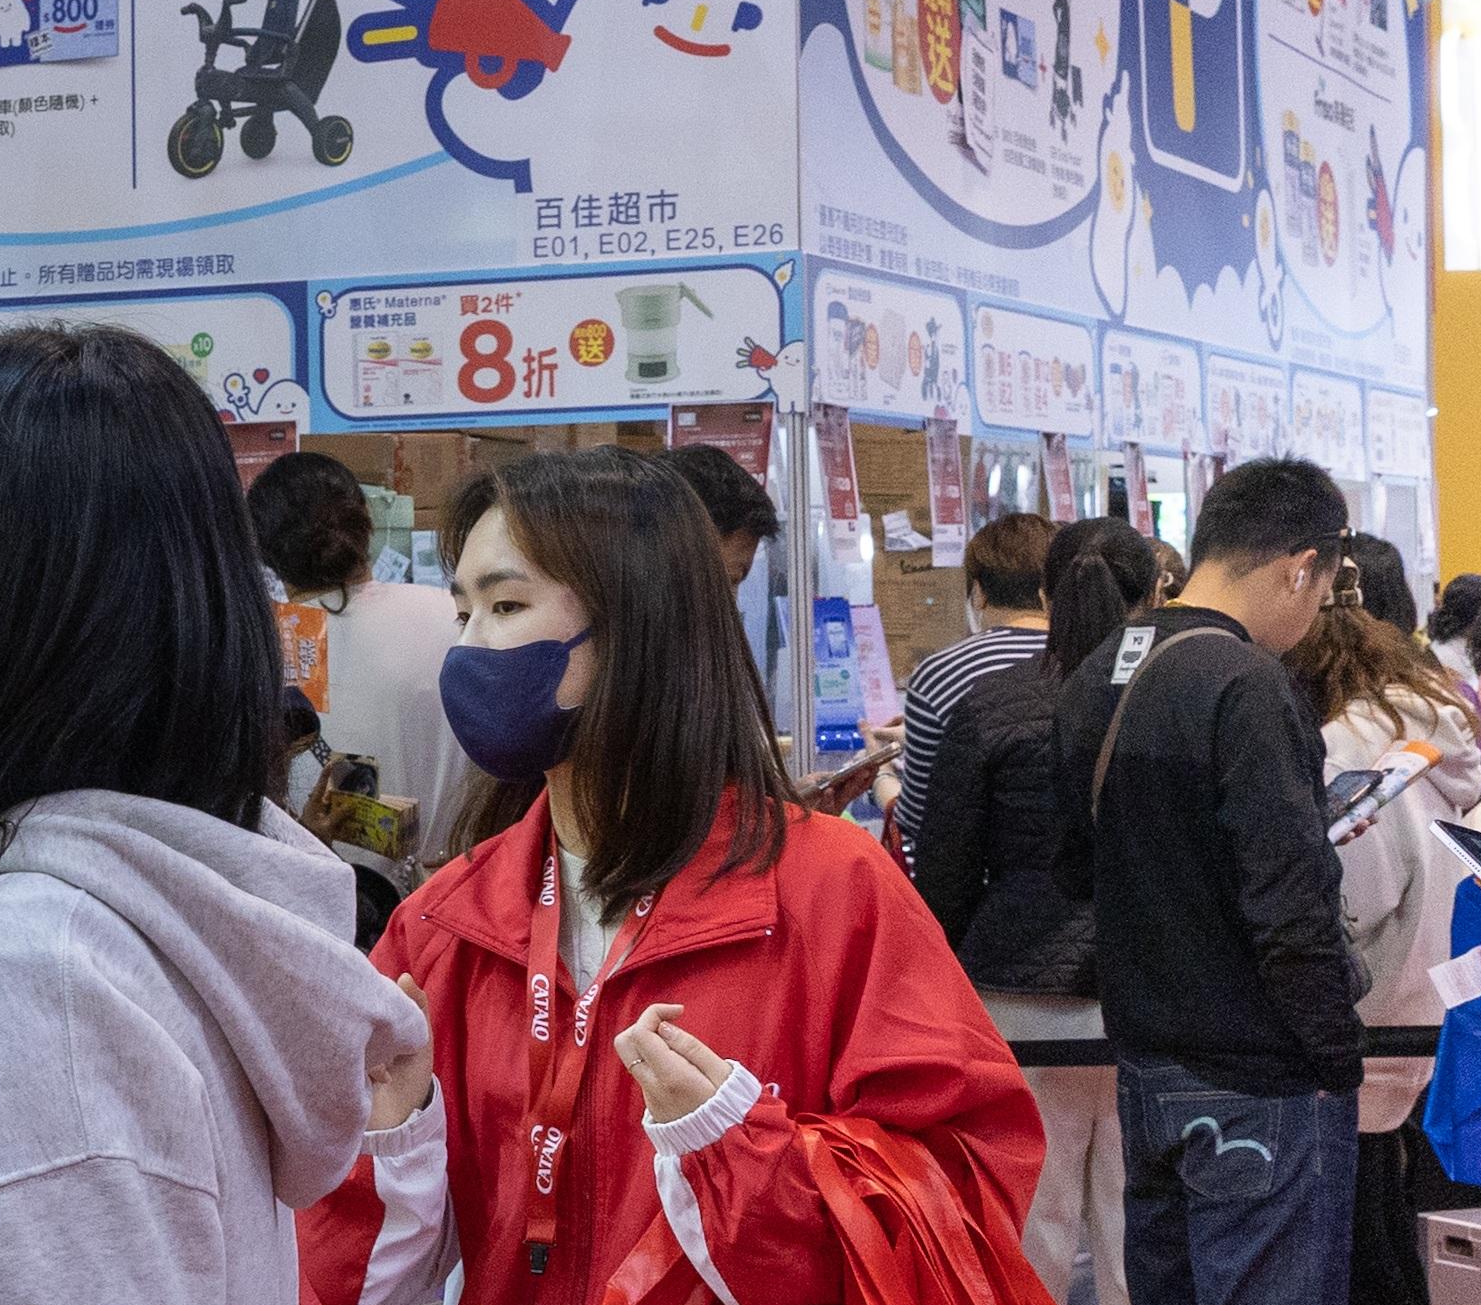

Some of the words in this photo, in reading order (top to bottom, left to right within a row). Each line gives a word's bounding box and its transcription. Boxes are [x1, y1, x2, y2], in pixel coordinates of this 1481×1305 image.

[535, 190, 680, 232] 百佳超市
[533, 235, 589, 260] E01,
[599, 232, 656, 257] E02,
[666, 228, 723, 254] E25,
[734, 223, 783, 248] E26
[349, 312, 418, 329] 營養補充品
[458, 318, 559, 403] 8折
[576, 337, 606, 366] 送
[530, 973, 550, 1042] CATALO
[574, 982, 599, 1047] CATALO
[536, 1125, 567, 1195] CATALO
